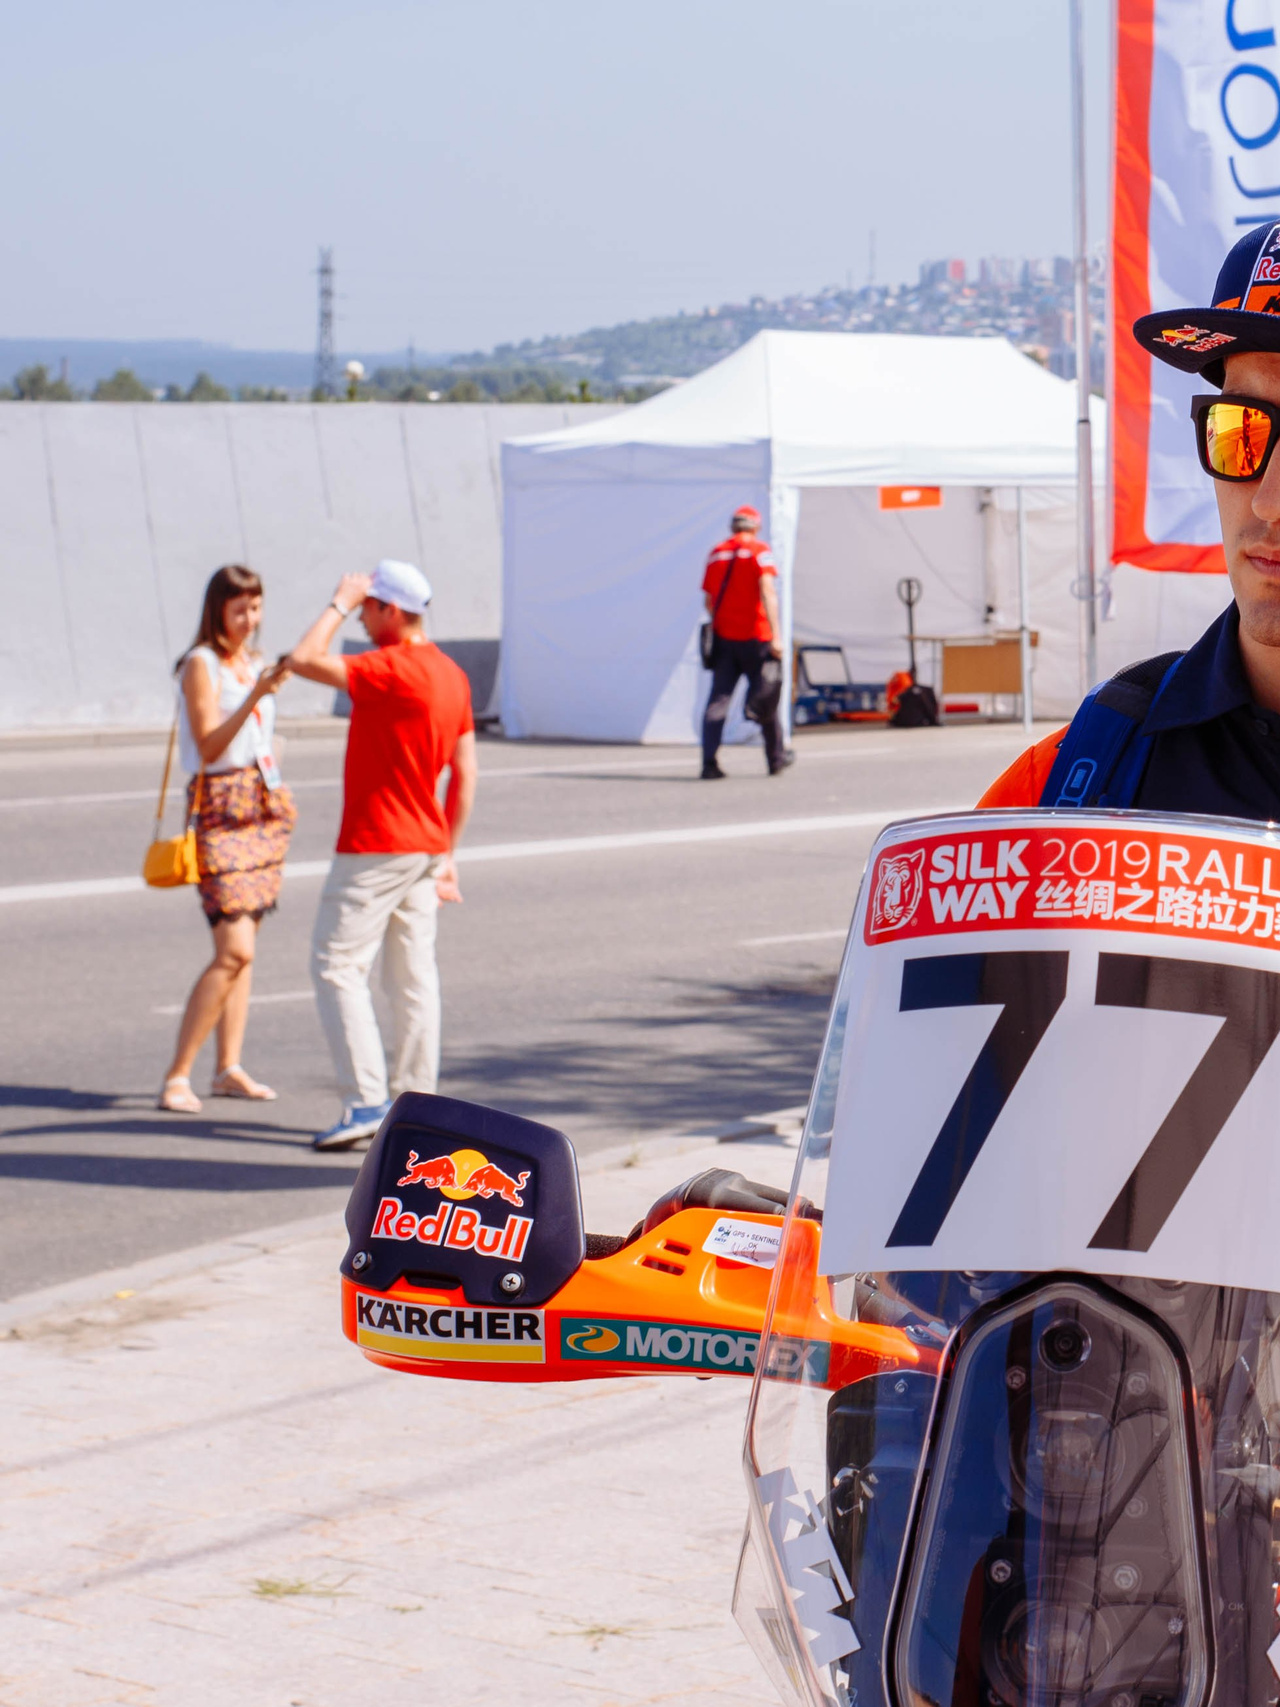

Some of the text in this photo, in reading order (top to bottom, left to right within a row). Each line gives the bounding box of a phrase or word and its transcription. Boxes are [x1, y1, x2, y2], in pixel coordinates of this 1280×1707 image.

[929, 839, 1031, 883] SILK
[1040, 838, 1150, 879] 2019
[928, 880, 1030, 923] WAY
[370, 1197, 534, 1262] Red Bull
[732, 1229, 746, 1238] GPS
[358, 1295, 541, 1340] KÄRCHER
[755, 1467, 862, 1668] KTM
